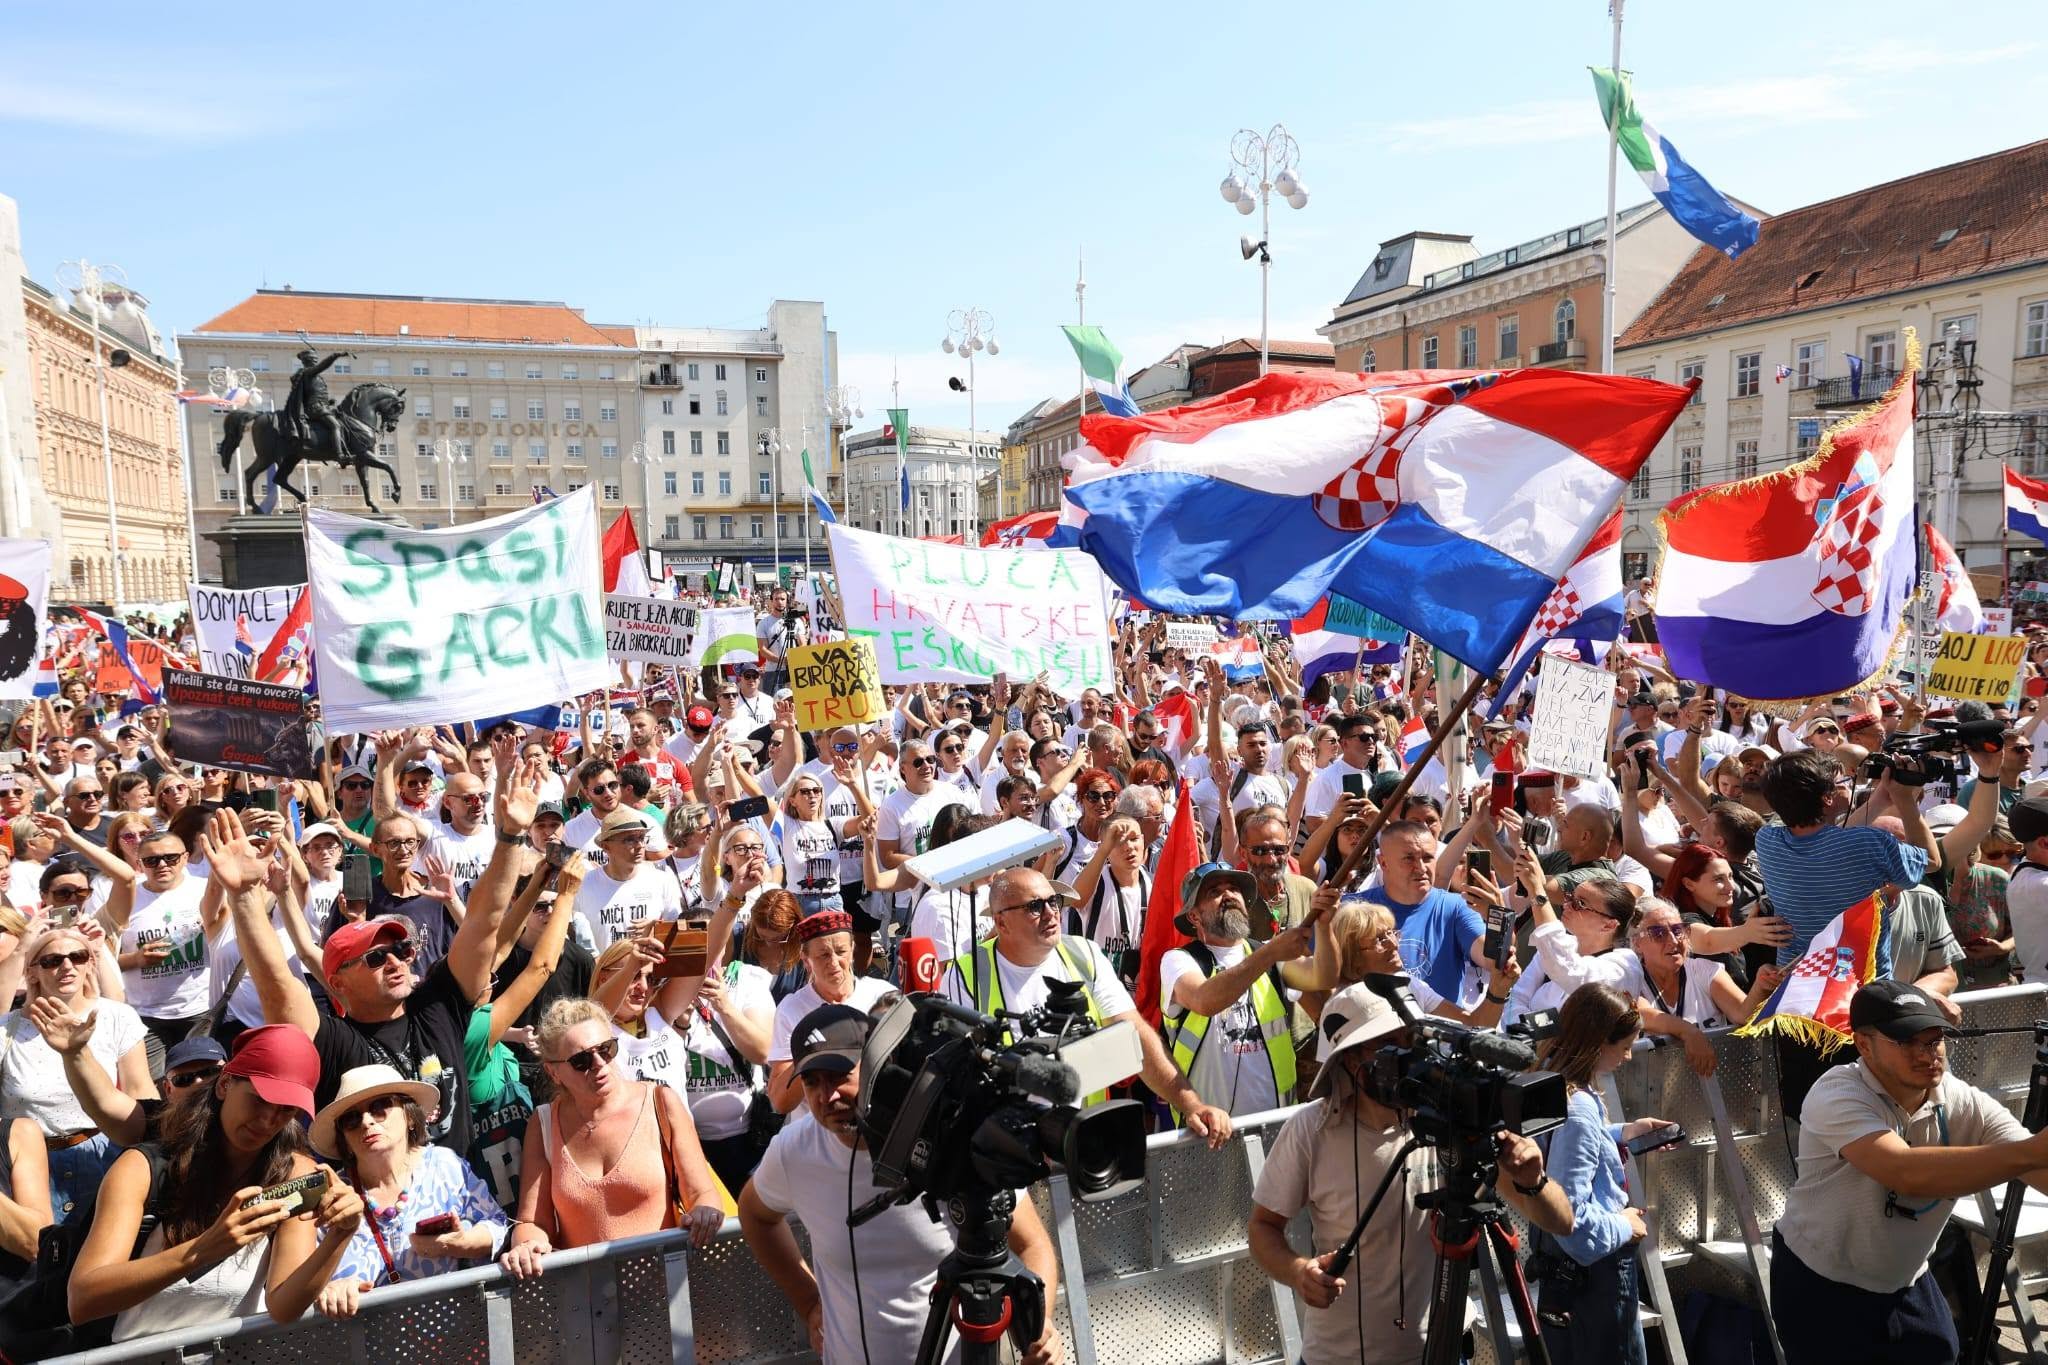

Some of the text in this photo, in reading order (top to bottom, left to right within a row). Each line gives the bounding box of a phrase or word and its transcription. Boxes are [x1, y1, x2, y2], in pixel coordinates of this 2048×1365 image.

[873, 589, 1096, 640] HRVATSKE
[102, 644, 134, 668] MII
[1937, 635, 1976, 661] AOJ
[1984, 640, 2026, 666] LIKO
[170, 672, 300, 700] Mislili ste da smo ovce??
[830, 677, 874, 698] NAS
[1581, 705, 1596, 722] SE
[600, 904, 624, 925] MIČI
[648, 1049, 672, 1072] TO!
[700, 1077, 712, 1088] ZA
[1439, 1258, 1450, 1304] sachtler
